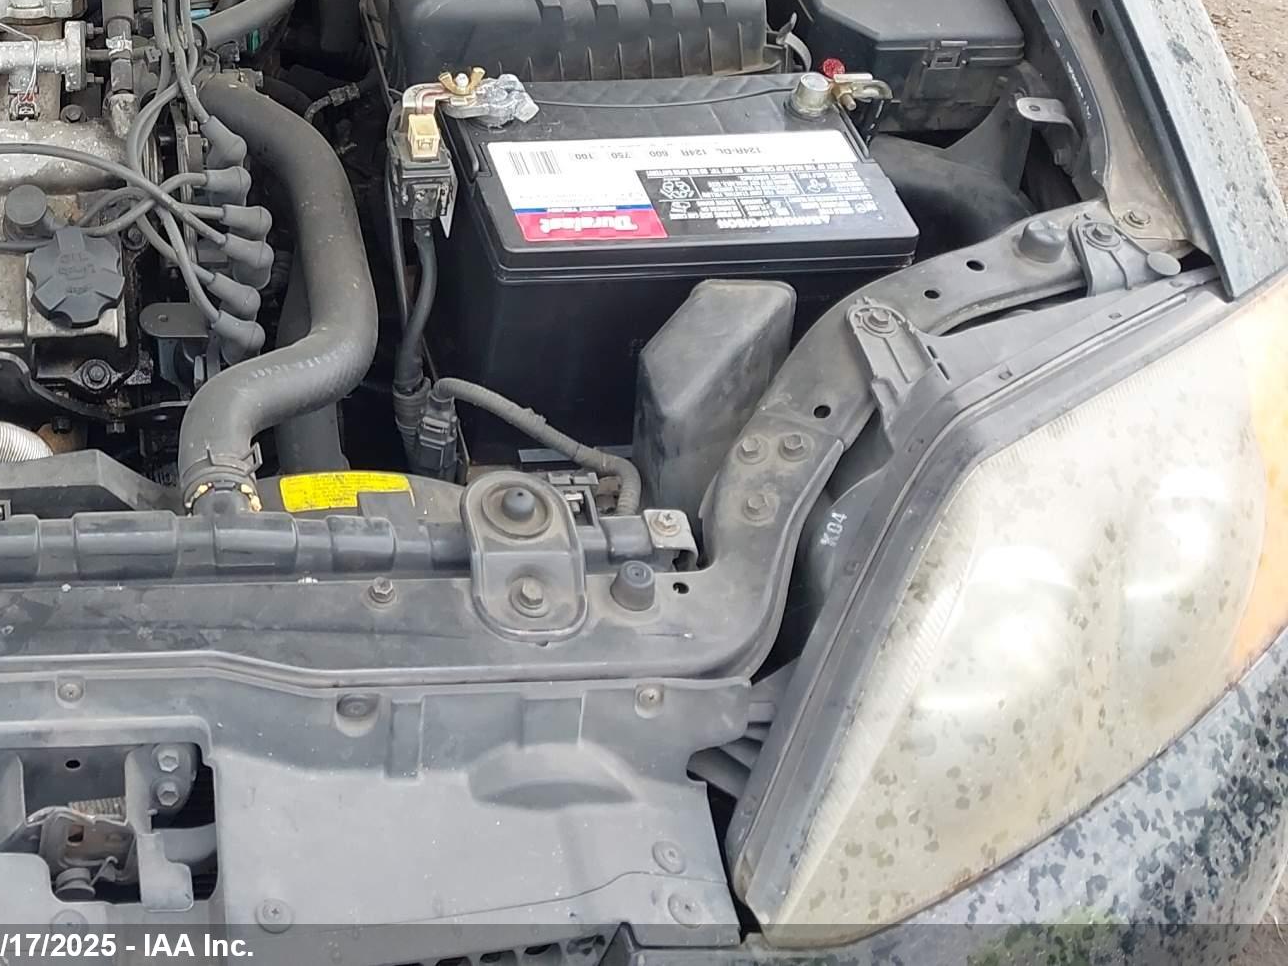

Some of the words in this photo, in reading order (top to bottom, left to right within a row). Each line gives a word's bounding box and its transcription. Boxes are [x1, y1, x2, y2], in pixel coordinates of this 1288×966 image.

[574, 152, 594, 160] 100
[611, 151, 632, 159] 750
[679, 149, 707, 157] 124R
[539, 215, 638, 233] Duralast
[820, 512, 847, 547] K04
